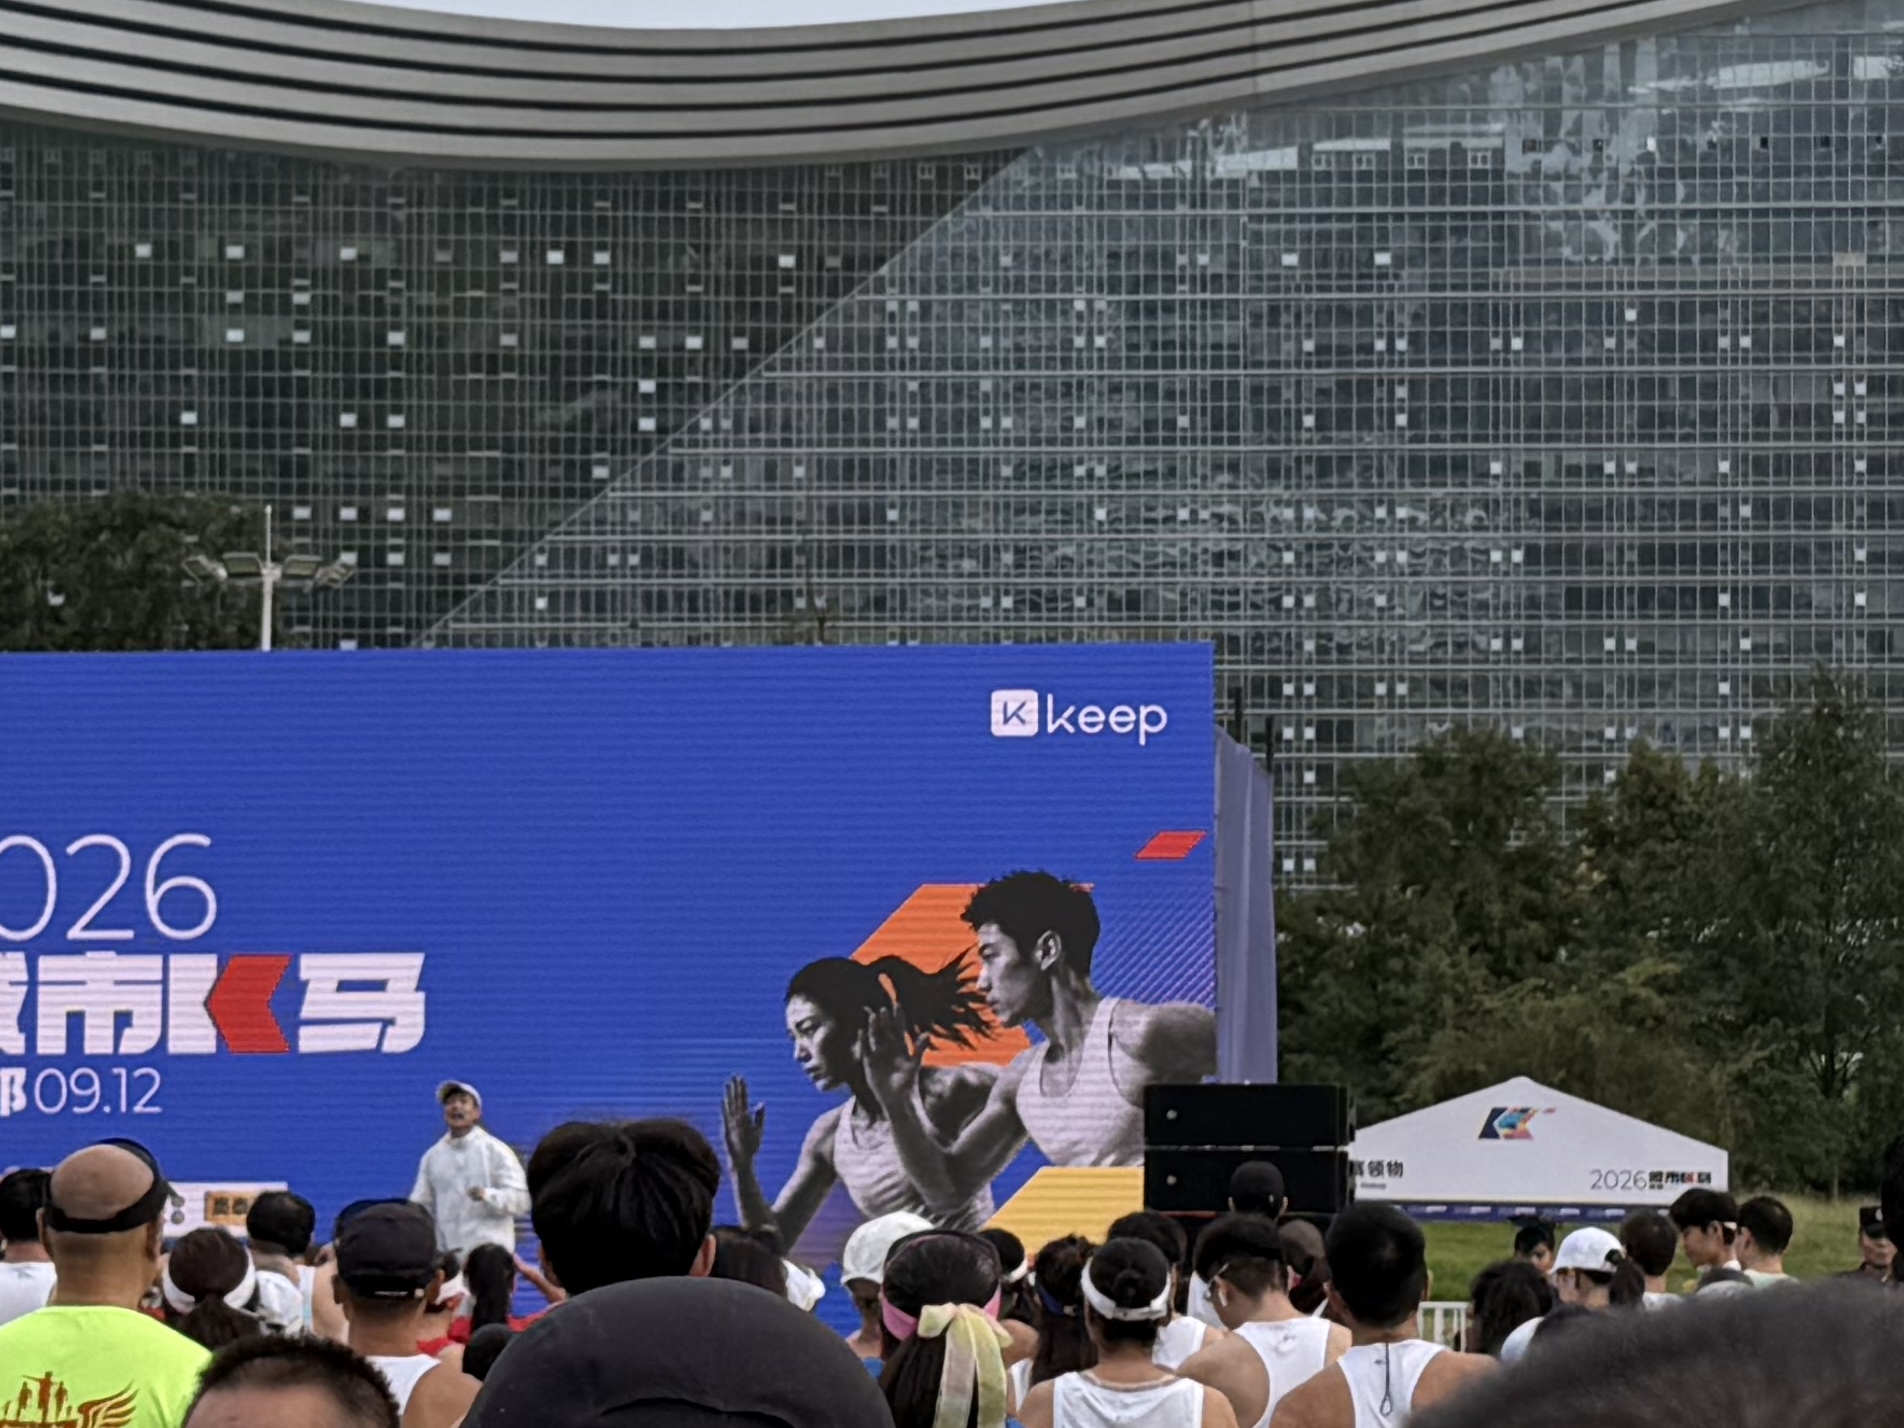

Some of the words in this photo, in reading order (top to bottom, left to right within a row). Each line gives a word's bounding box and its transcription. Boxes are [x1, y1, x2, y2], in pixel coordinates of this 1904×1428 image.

[1047, 694, 1168, 745] keep
[34, 1068, 163, 1115] 09.12
[1590, 1169, 1646, 1190] 2026
